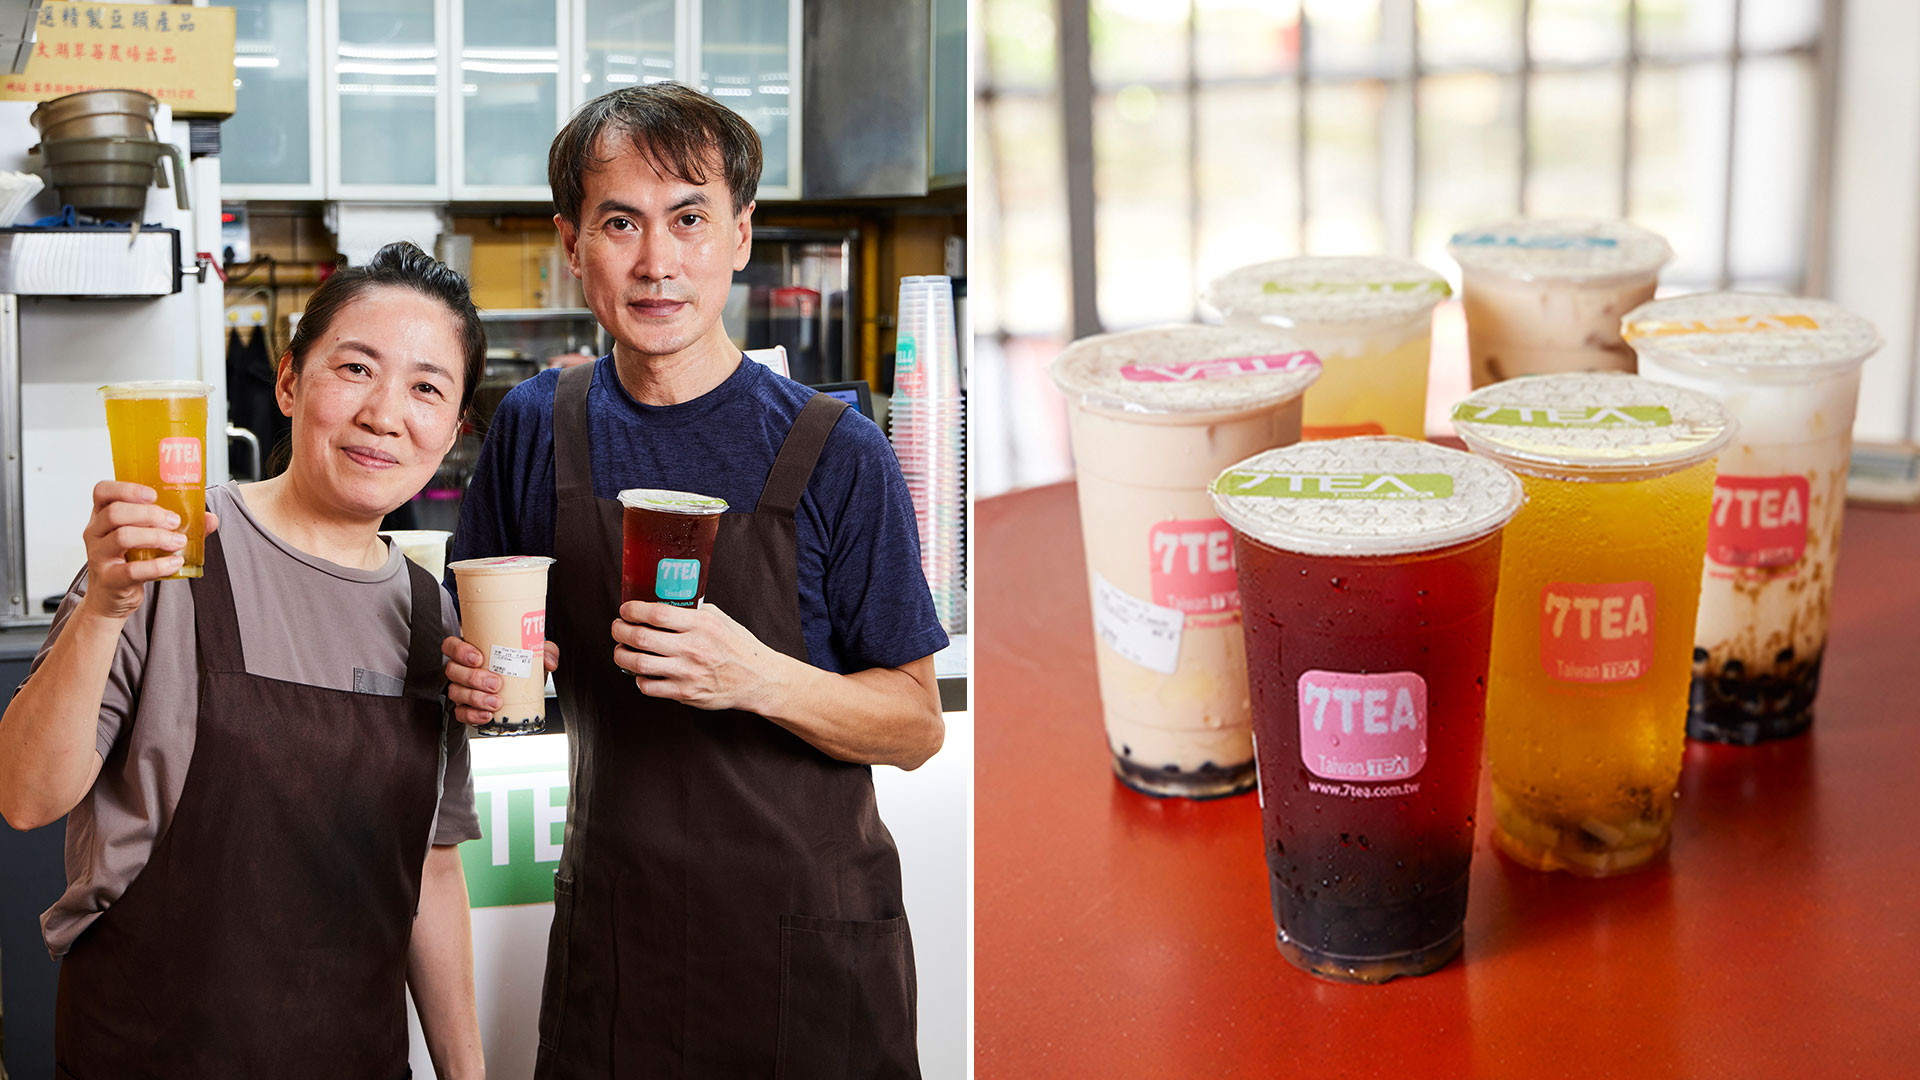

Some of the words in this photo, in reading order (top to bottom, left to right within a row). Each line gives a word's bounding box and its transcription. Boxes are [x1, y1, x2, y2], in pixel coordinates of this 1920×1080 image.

[1468, 403, 1645, 424] 7TEA
[161, 443, 200, 465] 7TEA
[1230, 470, 1418, 493] 7TEA
[1713, 486, 1803, 529] 7TEA
[1153, 531, 1237, 575] 7TE
[661, 561, 698, 580] 7TEA
[1545, 592, 1649, 640] 7TEA
[1304, 682, 1417, 735] 7TEA
[1318, 754, 1365, 777] Taiwan
[1367, 756, 1409, 777] TEA
[1308, 781, 1420, 798] www.7tea.com.tw
